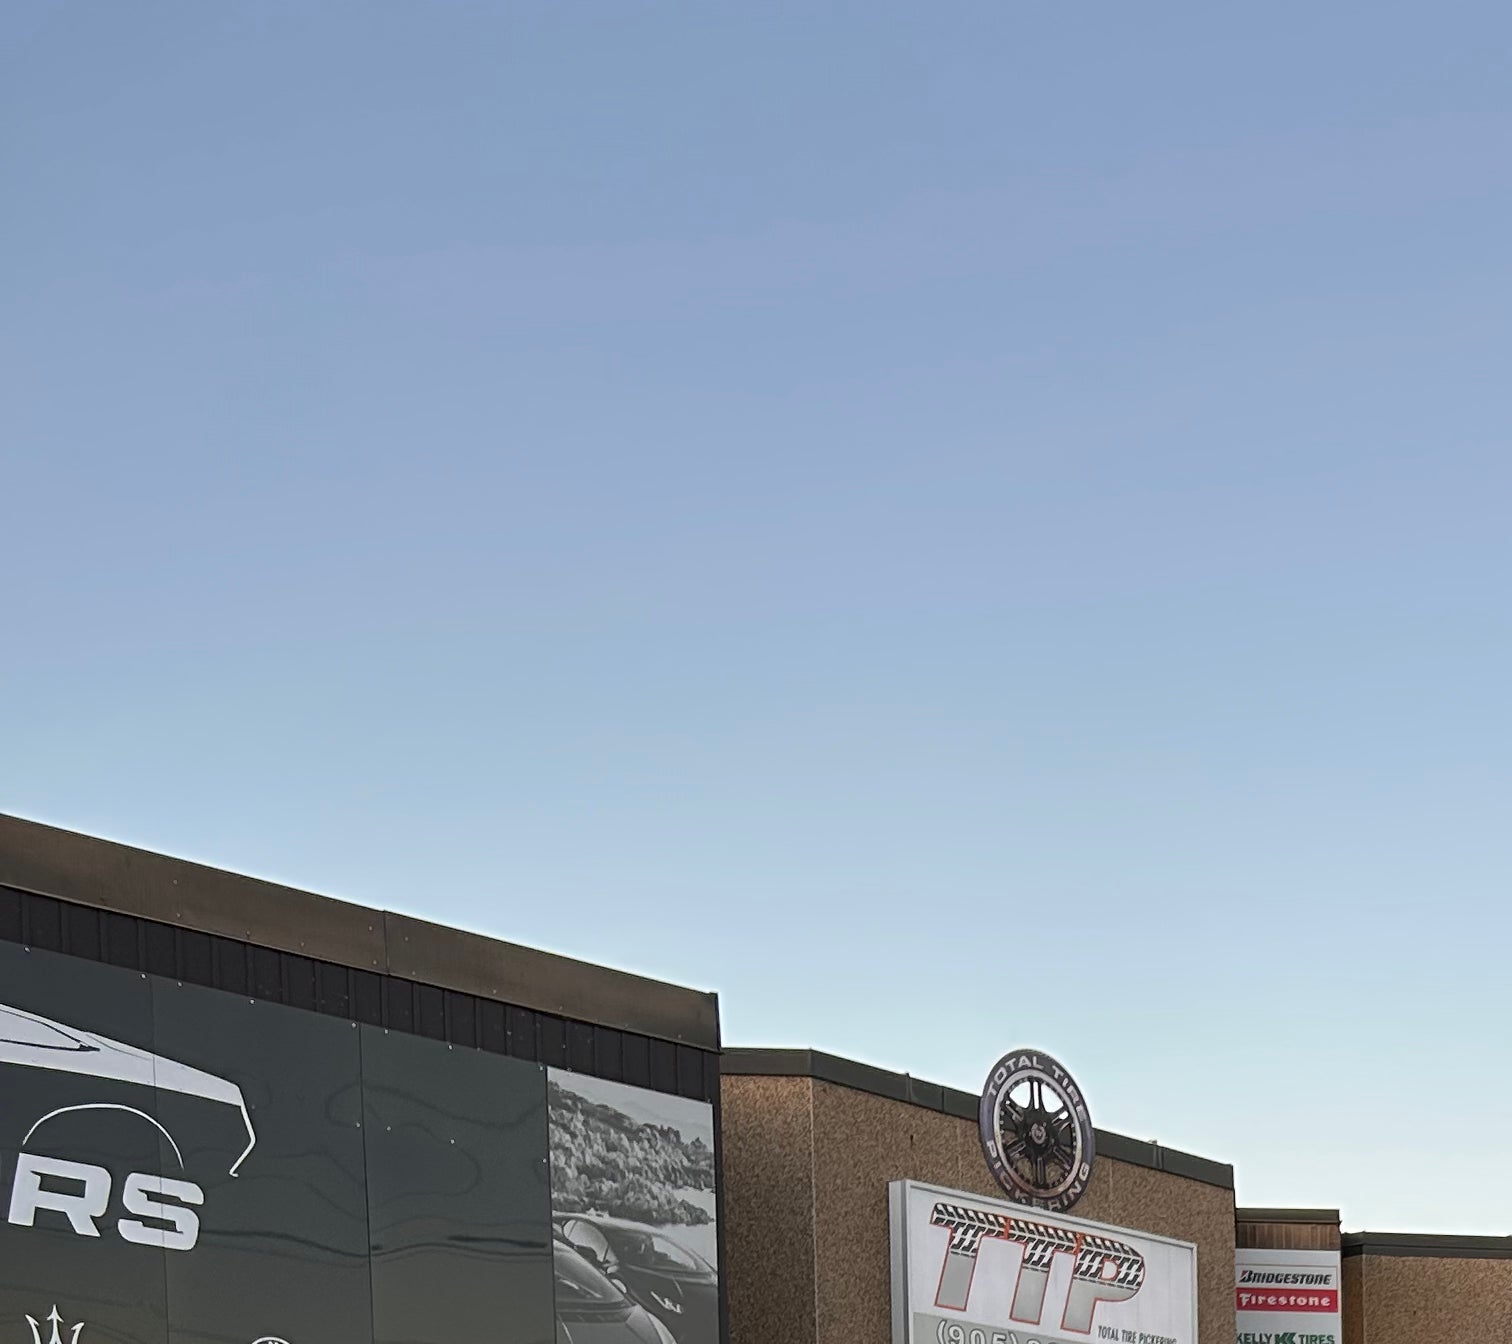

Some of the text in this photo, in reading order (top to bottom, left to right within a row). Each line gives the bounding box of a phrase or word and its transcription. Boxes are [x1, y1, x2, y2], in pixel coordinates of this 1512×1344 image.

[987, 1055, 1088, 1121] TOTAL TIRE
[929, 1202, 1146, 1335] TTP
[1240, 1270, 1332, 1285] BRIDGESTONE
[1239, 1293, 1331, 1307] Firestone
[1097, 1325, 1119, 1342] TOTAL
[1121, 1329, 1136, 1344] TIRE
